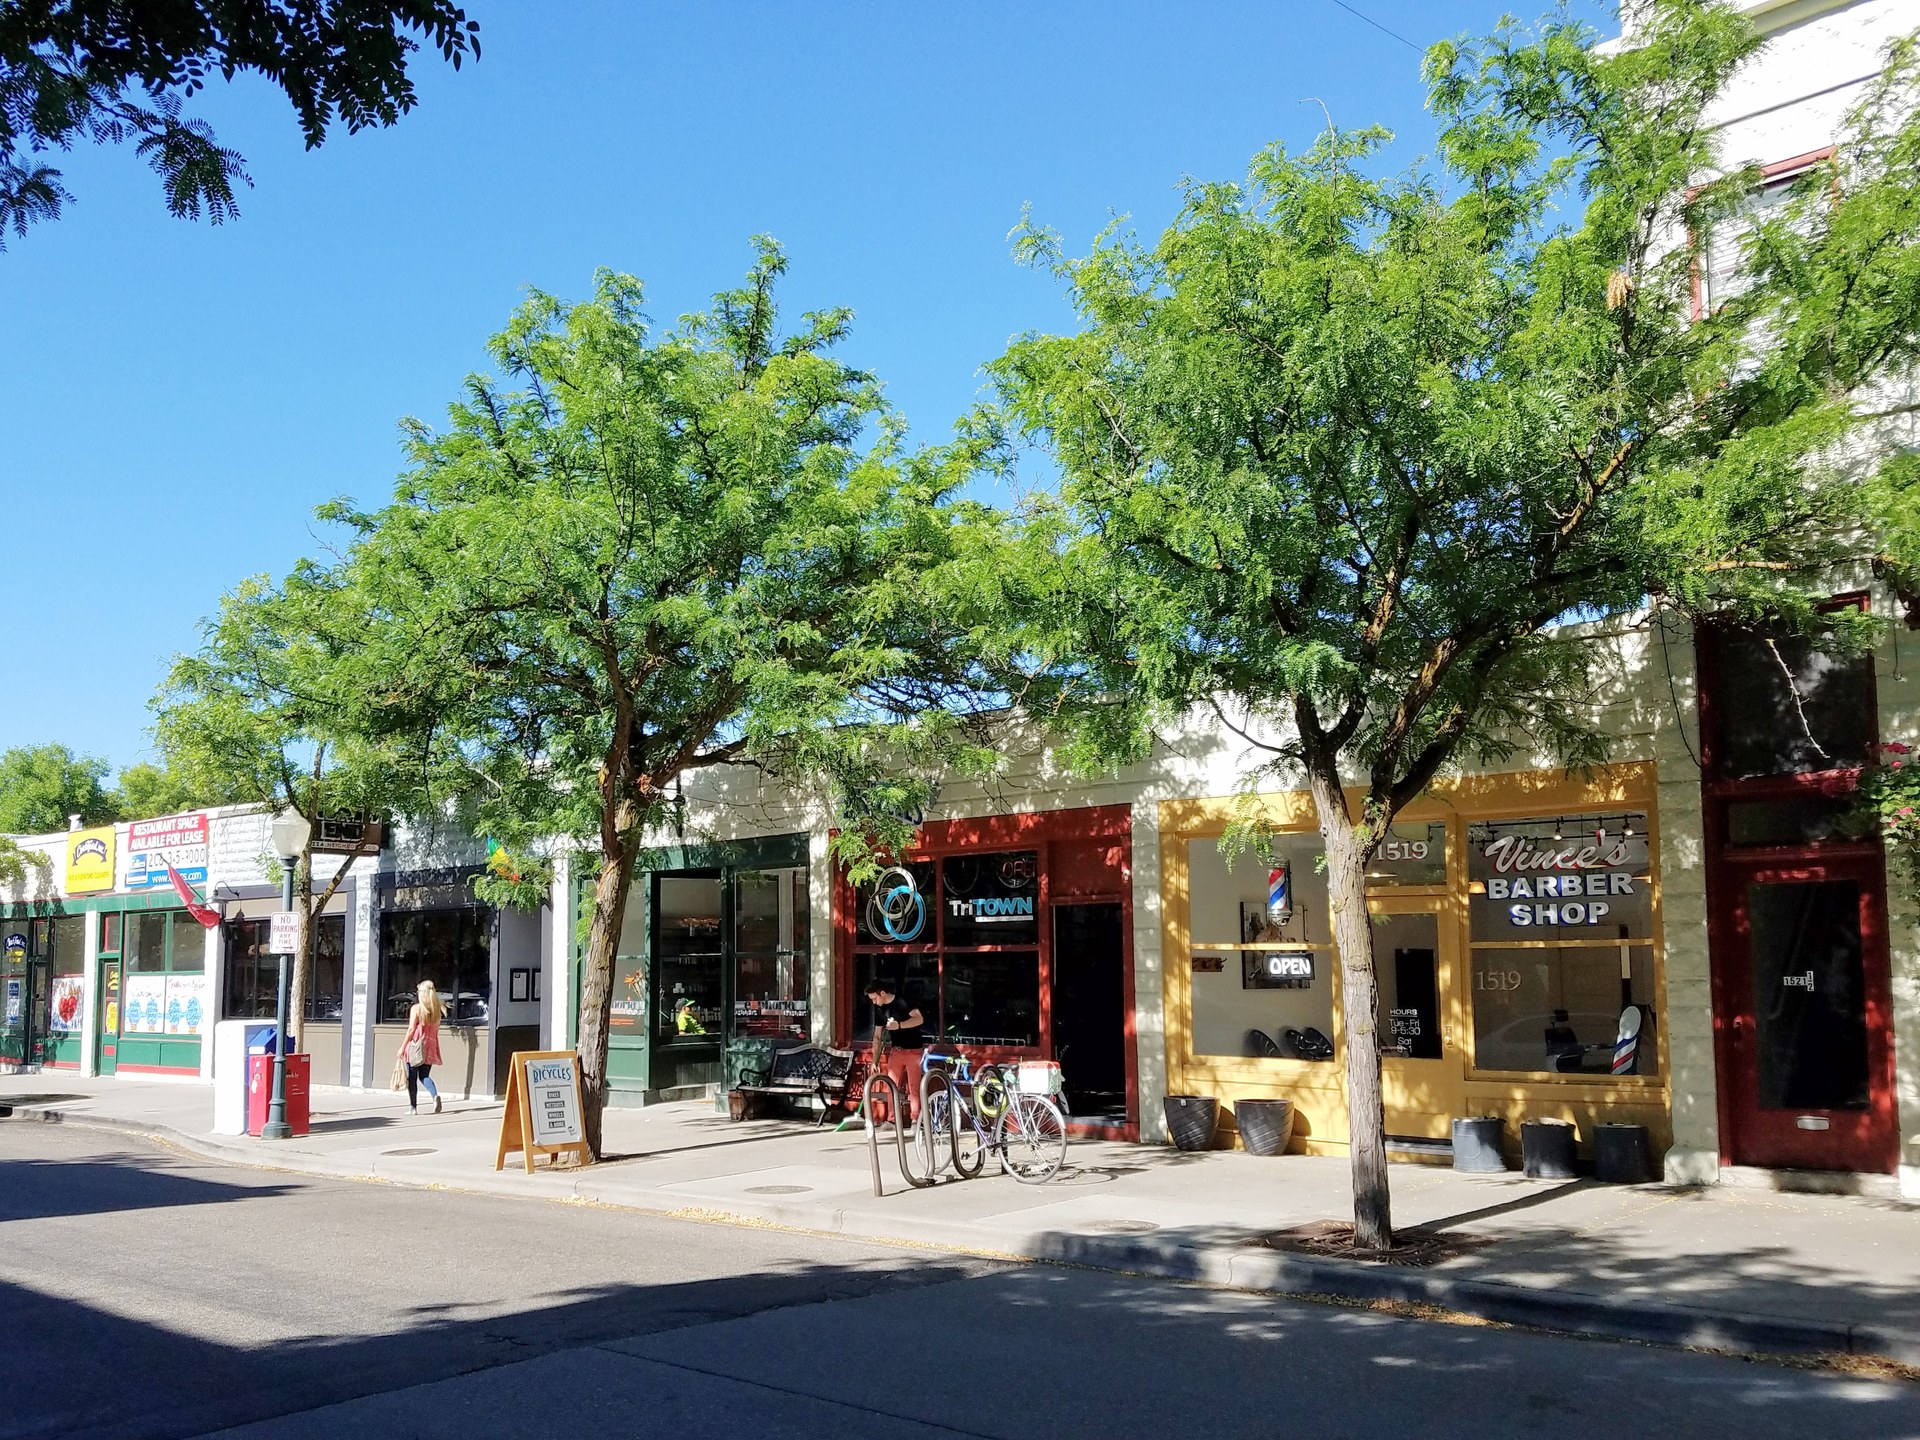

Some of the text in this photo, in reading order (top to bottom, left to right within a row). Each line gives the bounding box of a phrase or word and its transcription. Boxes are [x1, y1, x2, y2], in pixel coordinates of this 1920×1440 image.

[133, 815, 200, 836] RESTAURANT SPACE
[130, 829, 205, 851] AVAILABLE FOR LEASE
[1376, 841, 1429, 861] 1519
[1484, 828, 1631, 873] Vince's
[1487, 872, 1634, 900] BARBER
[949, 896, 1033, 916] TriTOWN
[1510, 902, 1610, 926] SHOP
[273, 925, 298, 933] PARKING
[280, 916, 292, 925] NO
[1269, 957, 1311, 975] OPEN
[1476, 970, 1522, 991] 1519
[1783, 977, 1807, 986] 1521
[1389, 1008, 1418, 1016] HOURS
[1390, 1026, 1421, 1036] 9-5:30
[1397, 1036, 1412, 1045] Sat
[285, 1072, 299, 1080] eekly
[533, 1067, 572, 1083] BICYCLES
